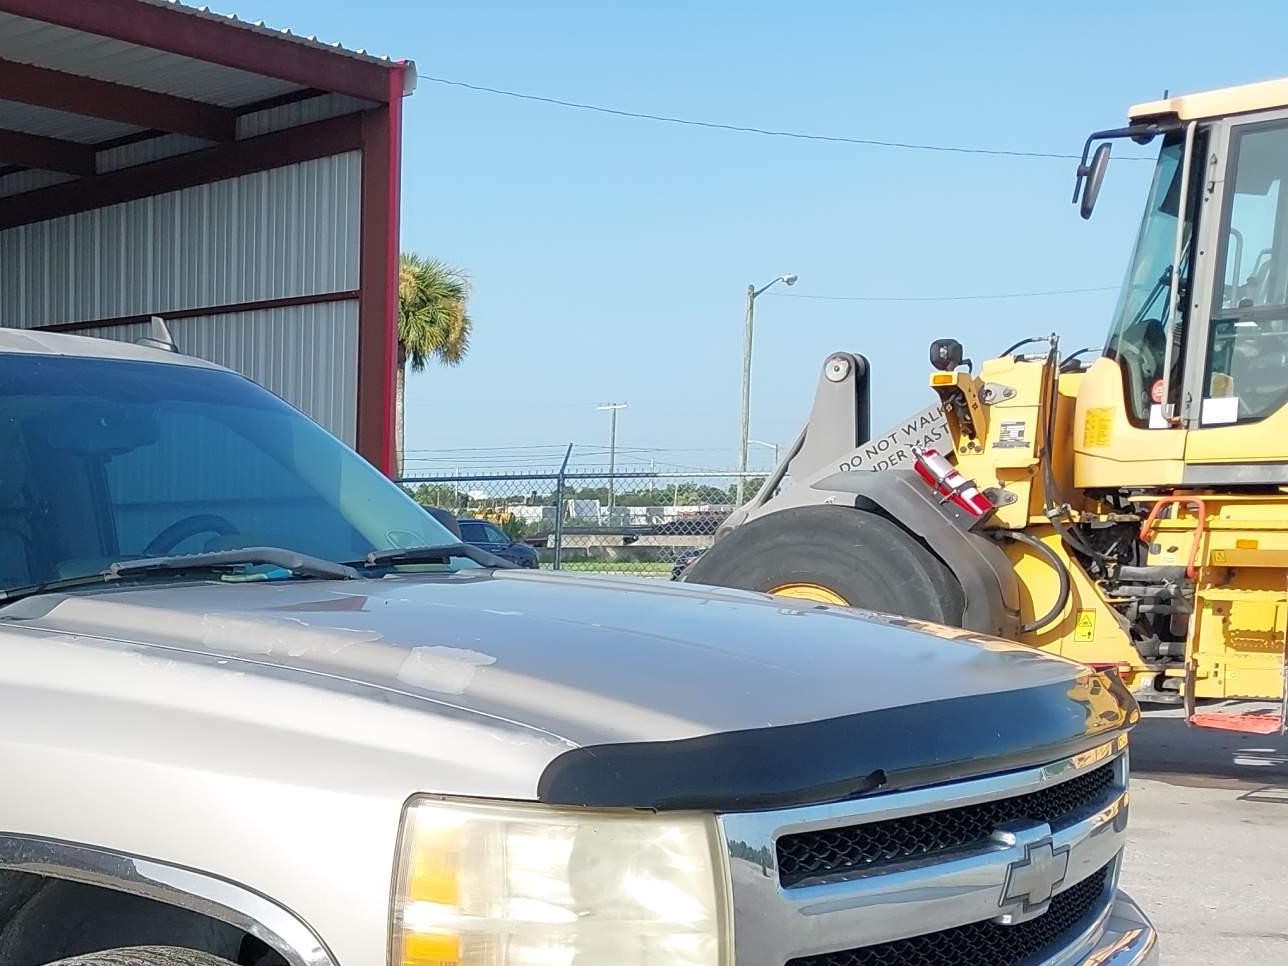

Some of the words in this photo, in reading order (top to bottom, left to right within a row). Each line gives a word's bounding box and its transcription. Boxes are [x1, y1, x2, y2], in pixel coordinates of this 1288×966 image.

[839, 455, 862, 472] DO
[865, 432, 898, 459] NOT
[870, 449, 908, 472] DER
[912, 422, 950, 450] AST
